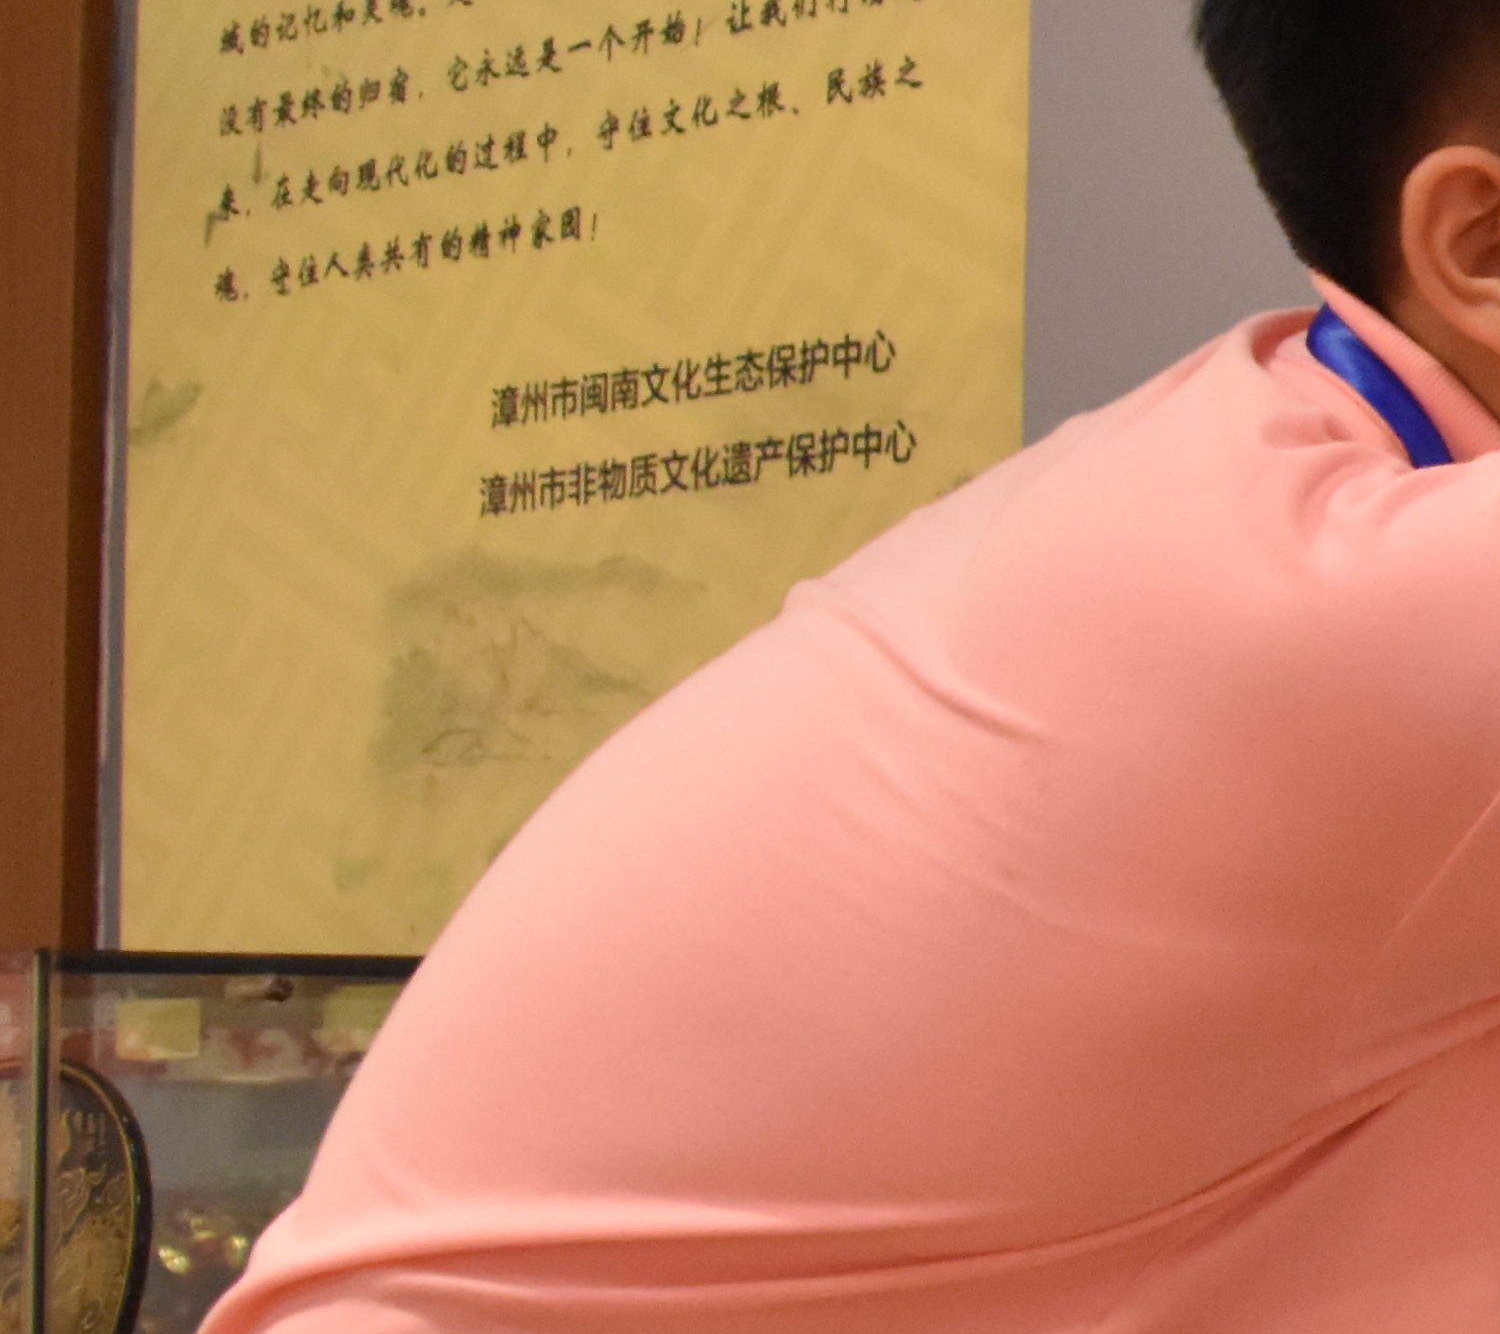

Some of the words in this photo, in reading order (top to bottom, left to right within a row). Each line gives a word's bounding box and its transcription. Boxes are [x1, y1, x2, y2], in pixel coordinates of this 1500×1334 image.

[490, 328, 898, 430] 漳州市闽南文化生态保护中心
[478, 419, 919, 518] 漳州市非物质文化遗产保护中心
